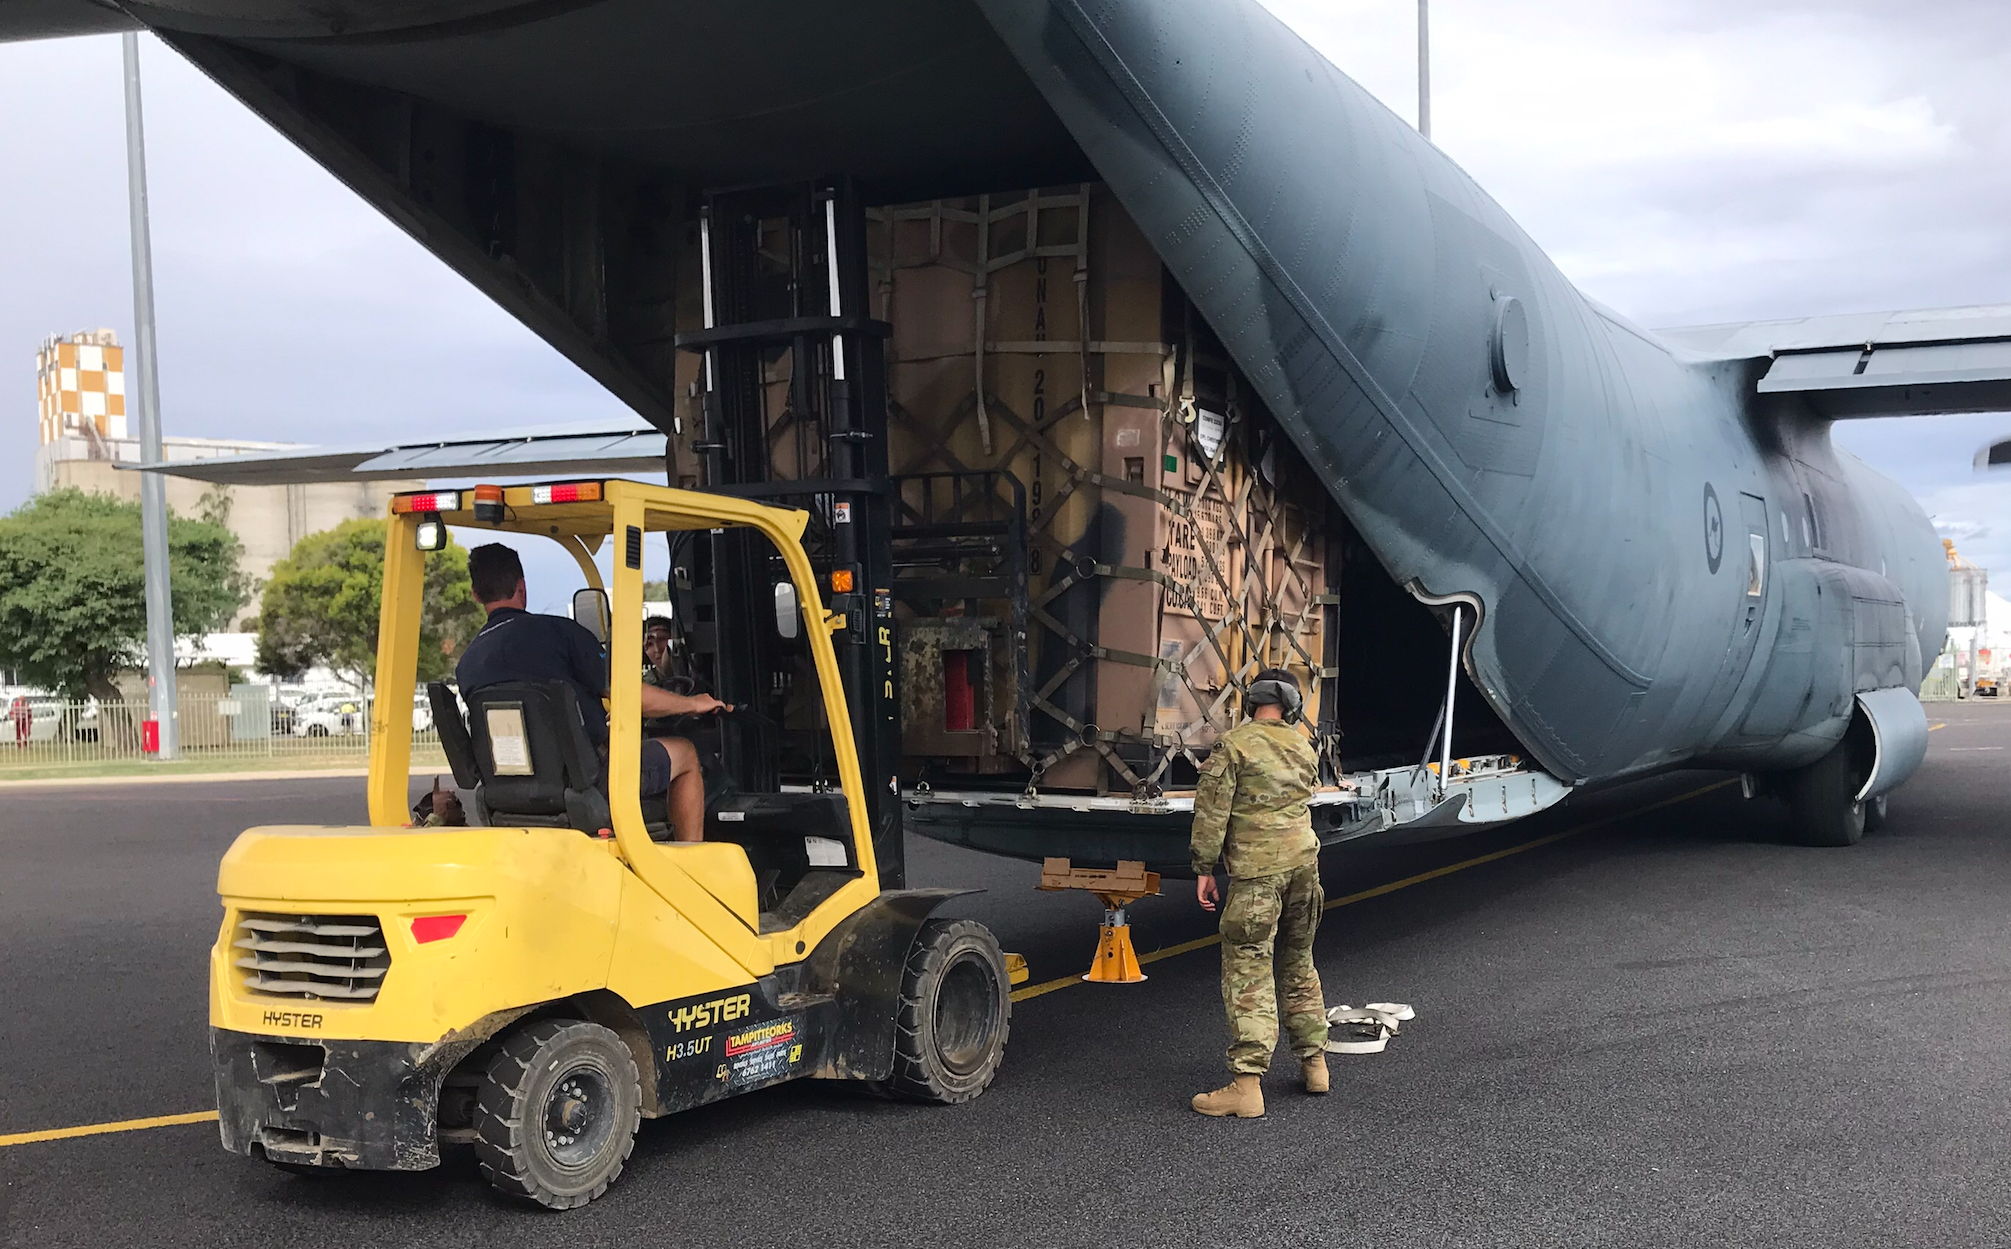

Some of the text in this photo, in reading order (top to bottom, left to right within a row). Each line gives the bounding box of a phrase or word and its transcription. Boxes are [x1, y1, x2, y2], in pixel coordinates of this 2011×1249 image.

[1169, 521, 1195, 550] TARE
[1168, 552, 1197, 580] PAYLOAD
[263, 1011, 323, 1029] HYSTER
[666, 1035, 713, 1062] H3.5UT
